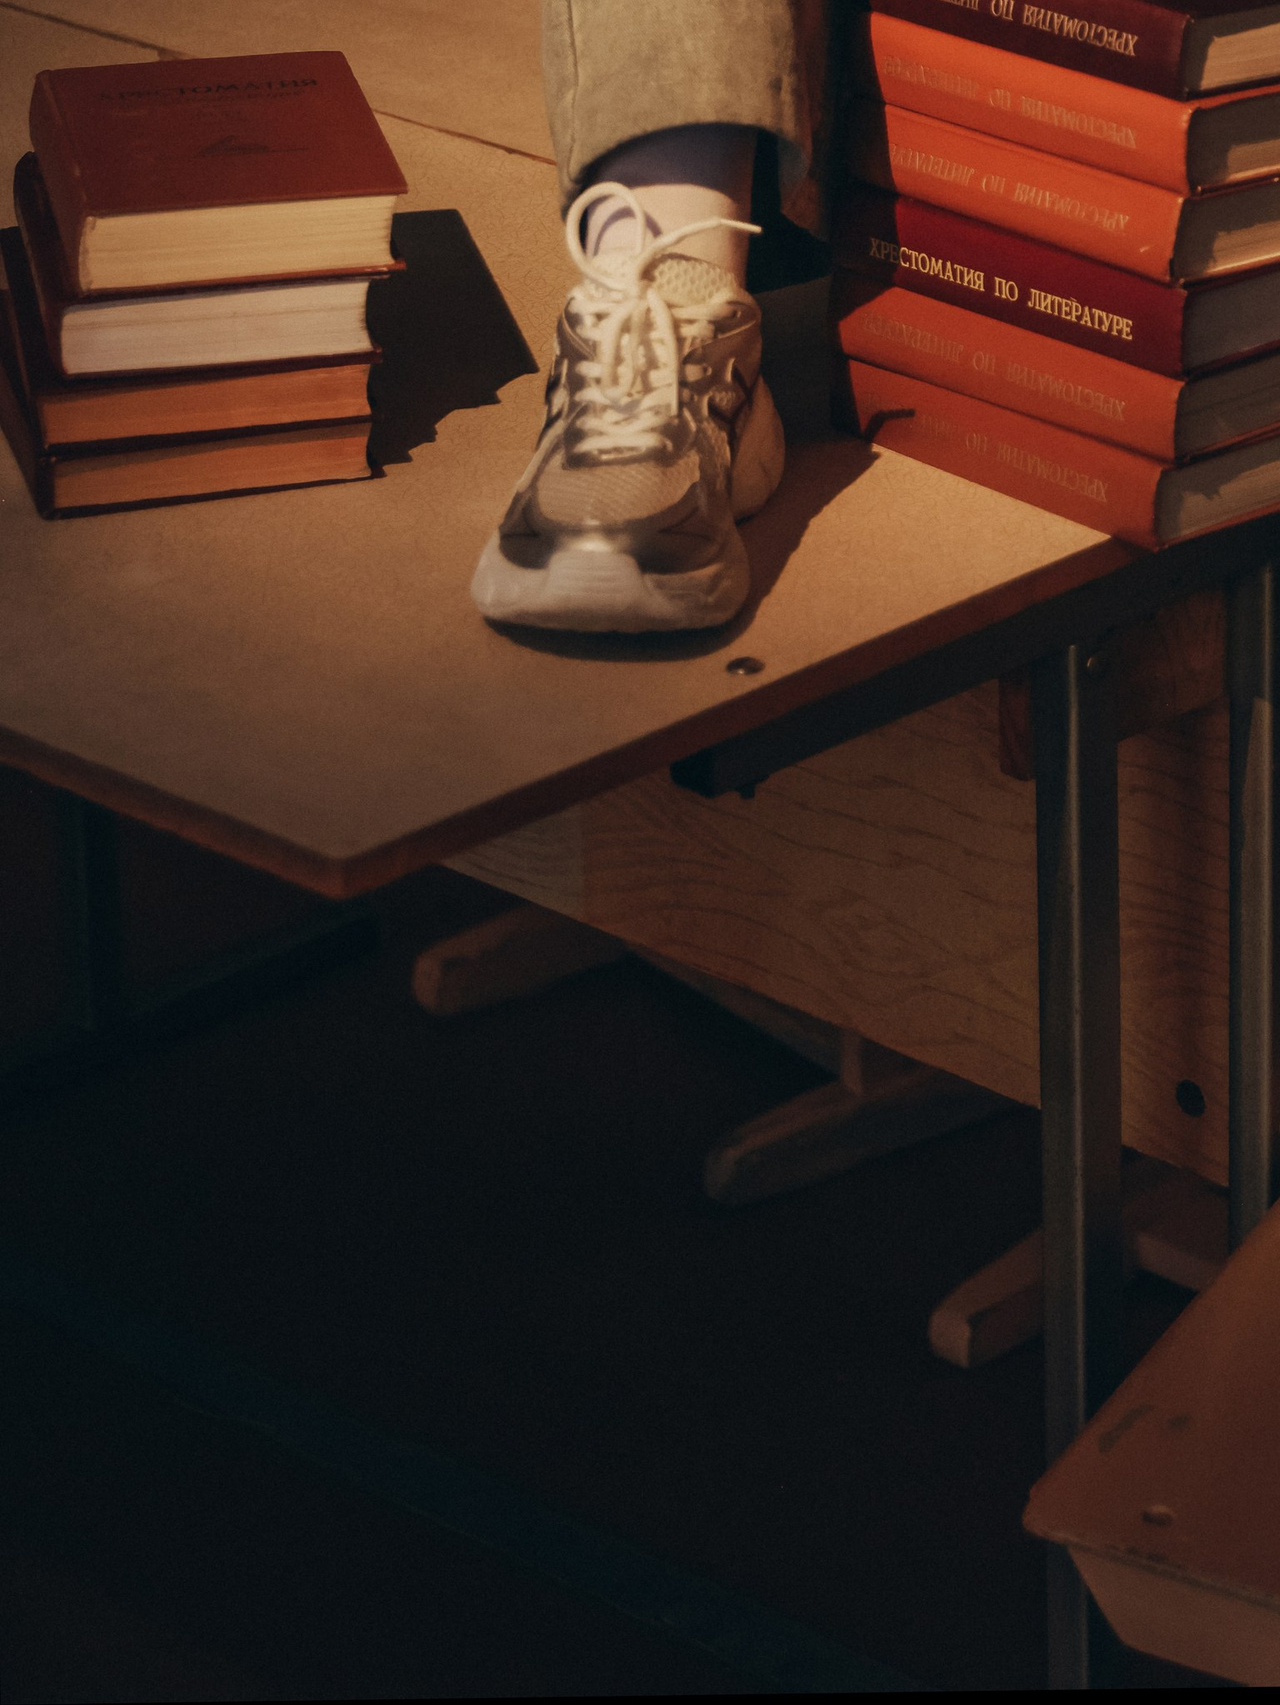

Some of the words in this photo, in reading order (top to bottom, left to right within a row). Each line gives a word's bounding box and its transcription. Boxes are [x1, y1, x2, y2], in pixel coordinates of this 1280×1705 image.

[1022, 3, 1138, 56] ХРЕСТОМАТИЯ
[988, 88, 1011, 109] ПО
[981, 172, 1006, 194] ПО
[869, 237, 985, 292] ХРЕСТОМАТИЯ
[994, 276, 1019, 302] ПО
[1027, 288, 1134, 341] ЛИТЕРАТУРЕ
[972, 351, 997, 375] ПО
